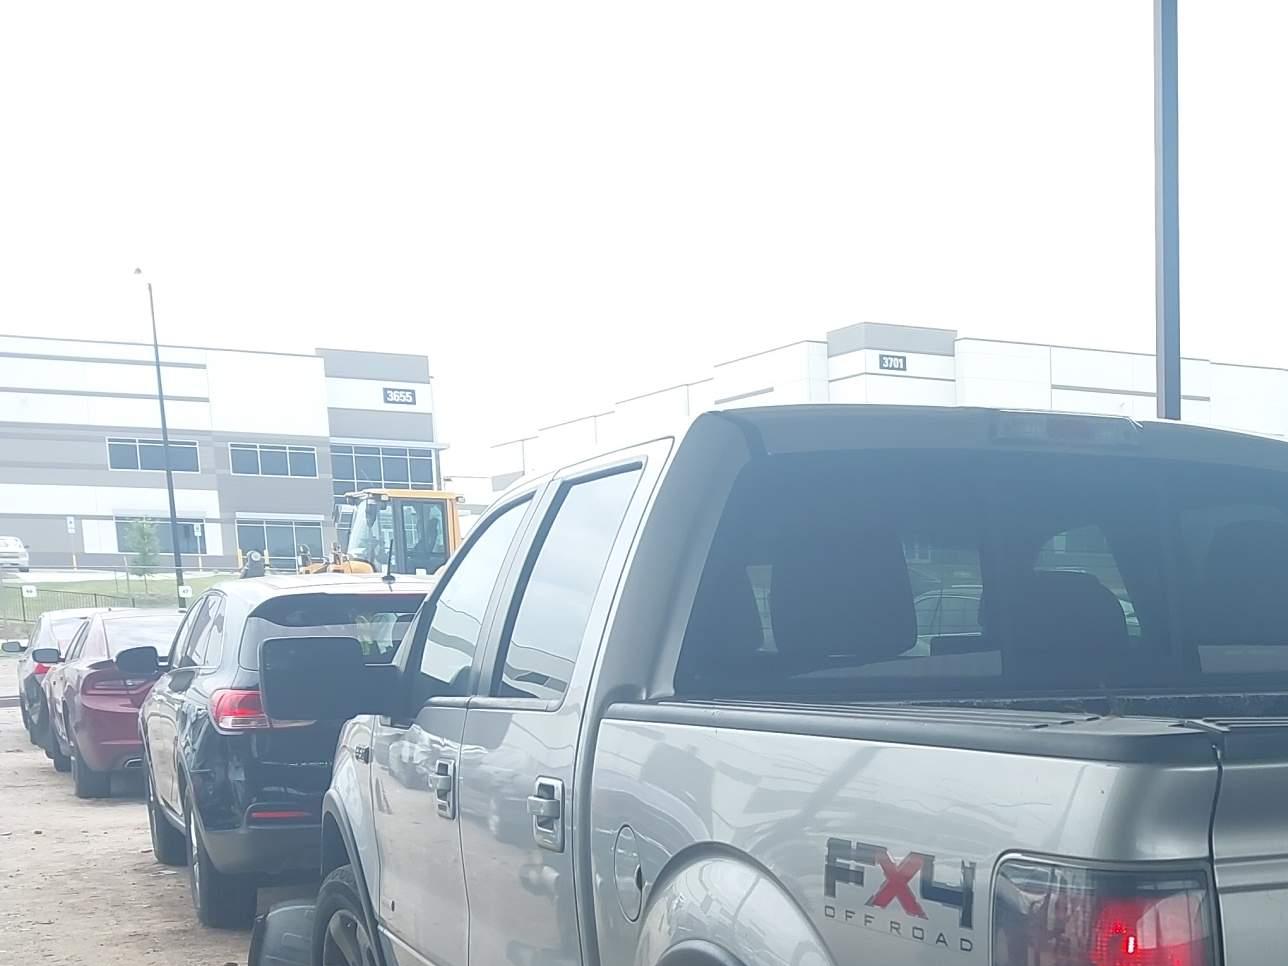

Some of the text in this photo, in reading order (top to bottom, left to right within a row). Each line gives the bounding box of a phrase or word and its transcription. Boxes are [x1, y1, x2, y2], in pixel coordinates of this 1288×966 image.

[882, 356, 904, 369] 3701
[386, 390, 413, 402] 3655
[824, 837, 976, 930] FX4
